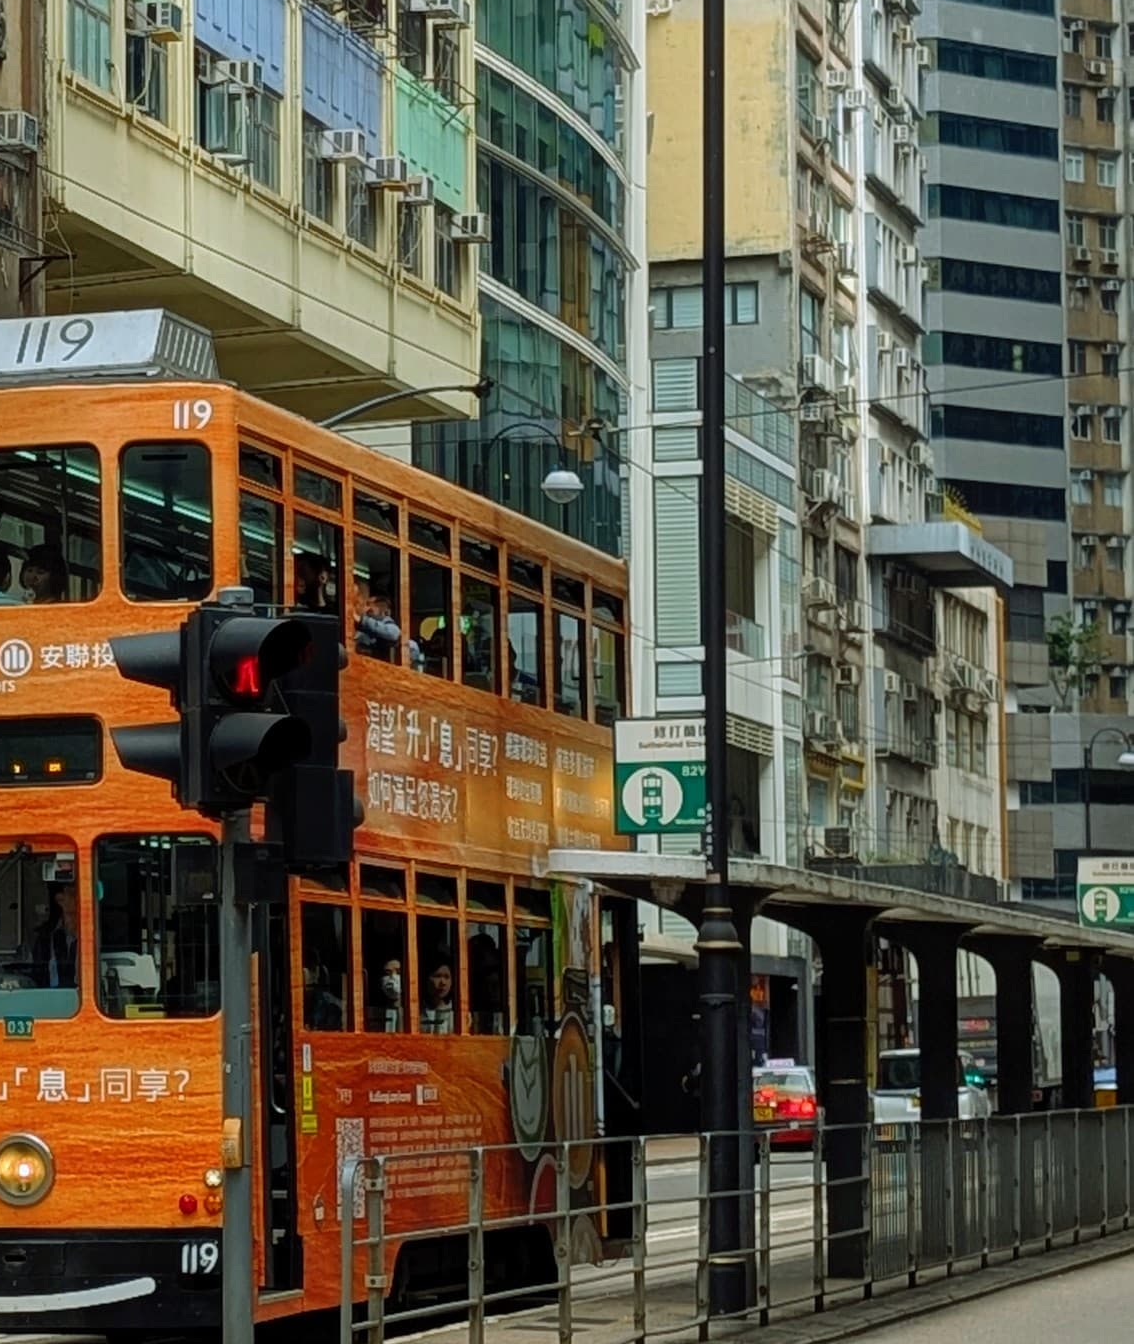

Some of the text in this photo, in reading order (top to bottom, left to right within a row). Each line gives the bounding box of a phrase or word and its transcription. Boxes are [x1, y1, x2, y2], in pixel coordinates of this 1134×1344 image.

[15, 318, 94, 364] 119
[173, 400, 212, 430] 119
[181, 1241, 219, 1275] 119
